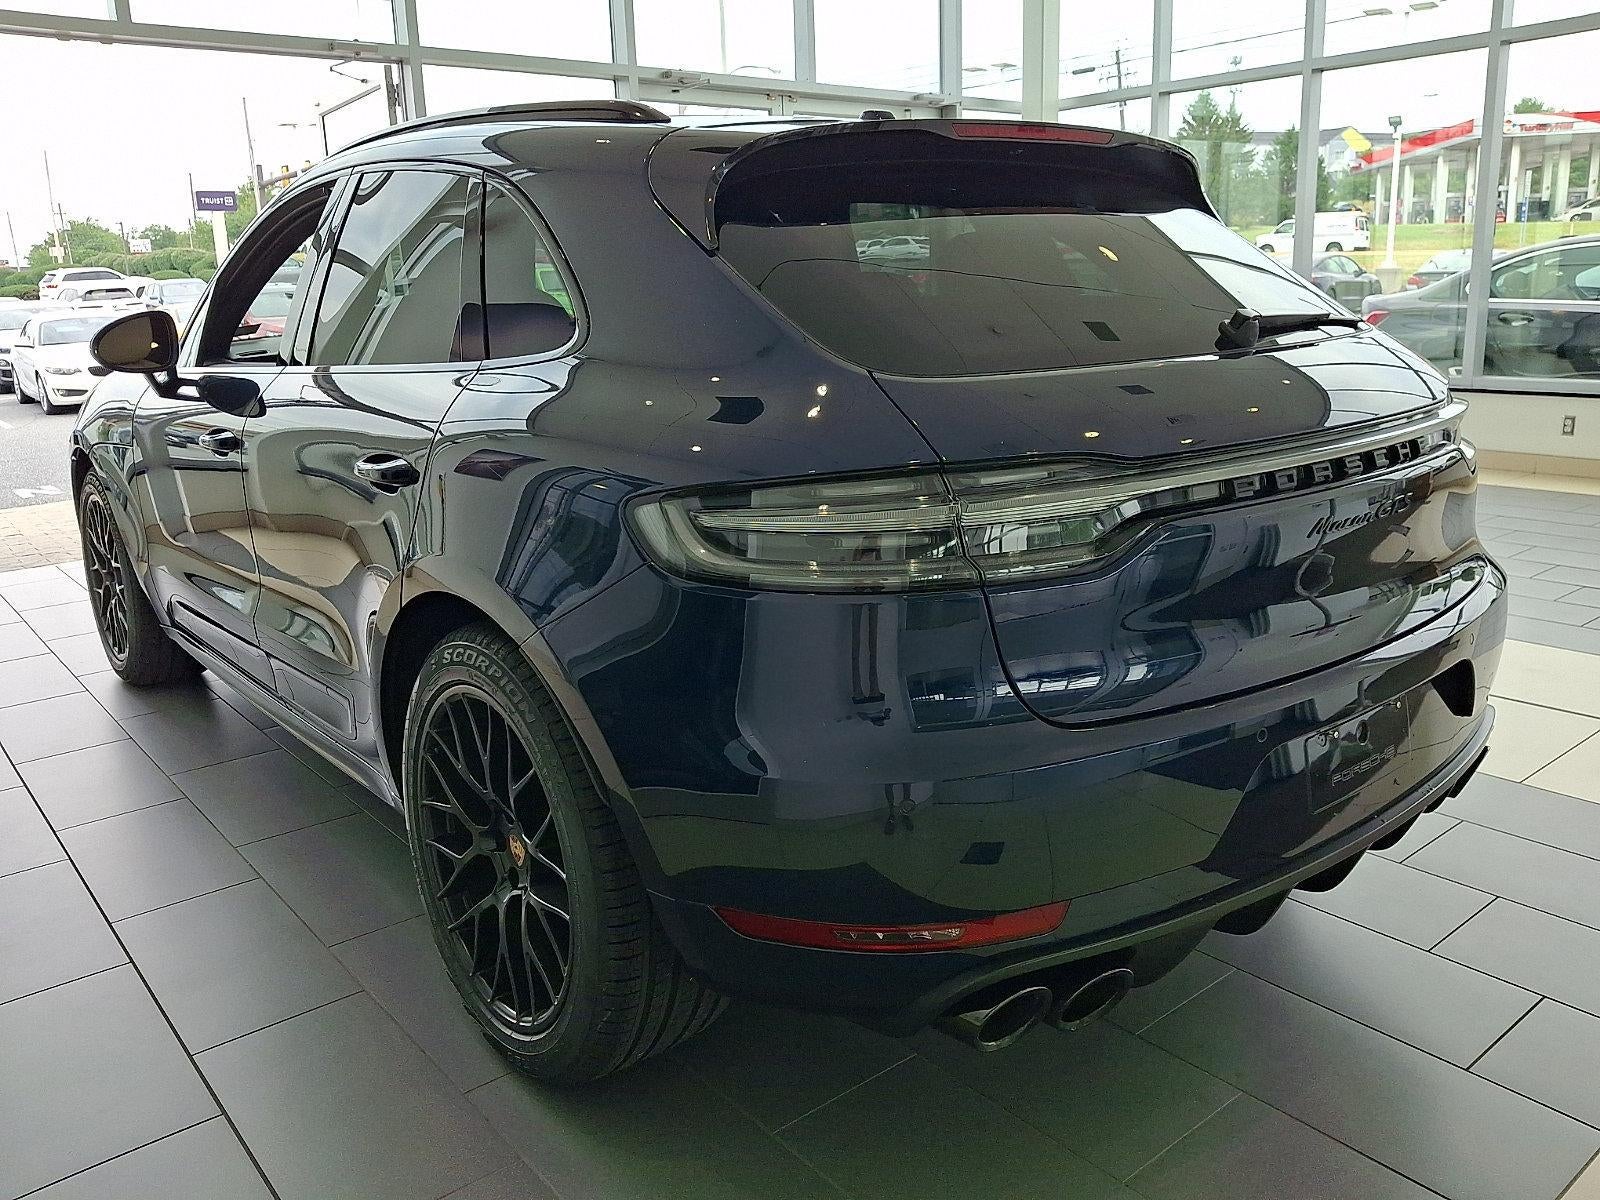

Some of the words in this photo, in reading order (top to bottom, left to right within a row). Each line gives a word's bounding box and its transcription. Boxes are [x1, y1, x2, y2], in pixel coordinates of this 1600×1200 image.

[200, 197, 224, 205] TRUIST
[1233, 437, 1433, 498] PORSCHE
[442, 647, 536, 724] SCORPION
[1331, 744, 1397, 787] PORSCHE
